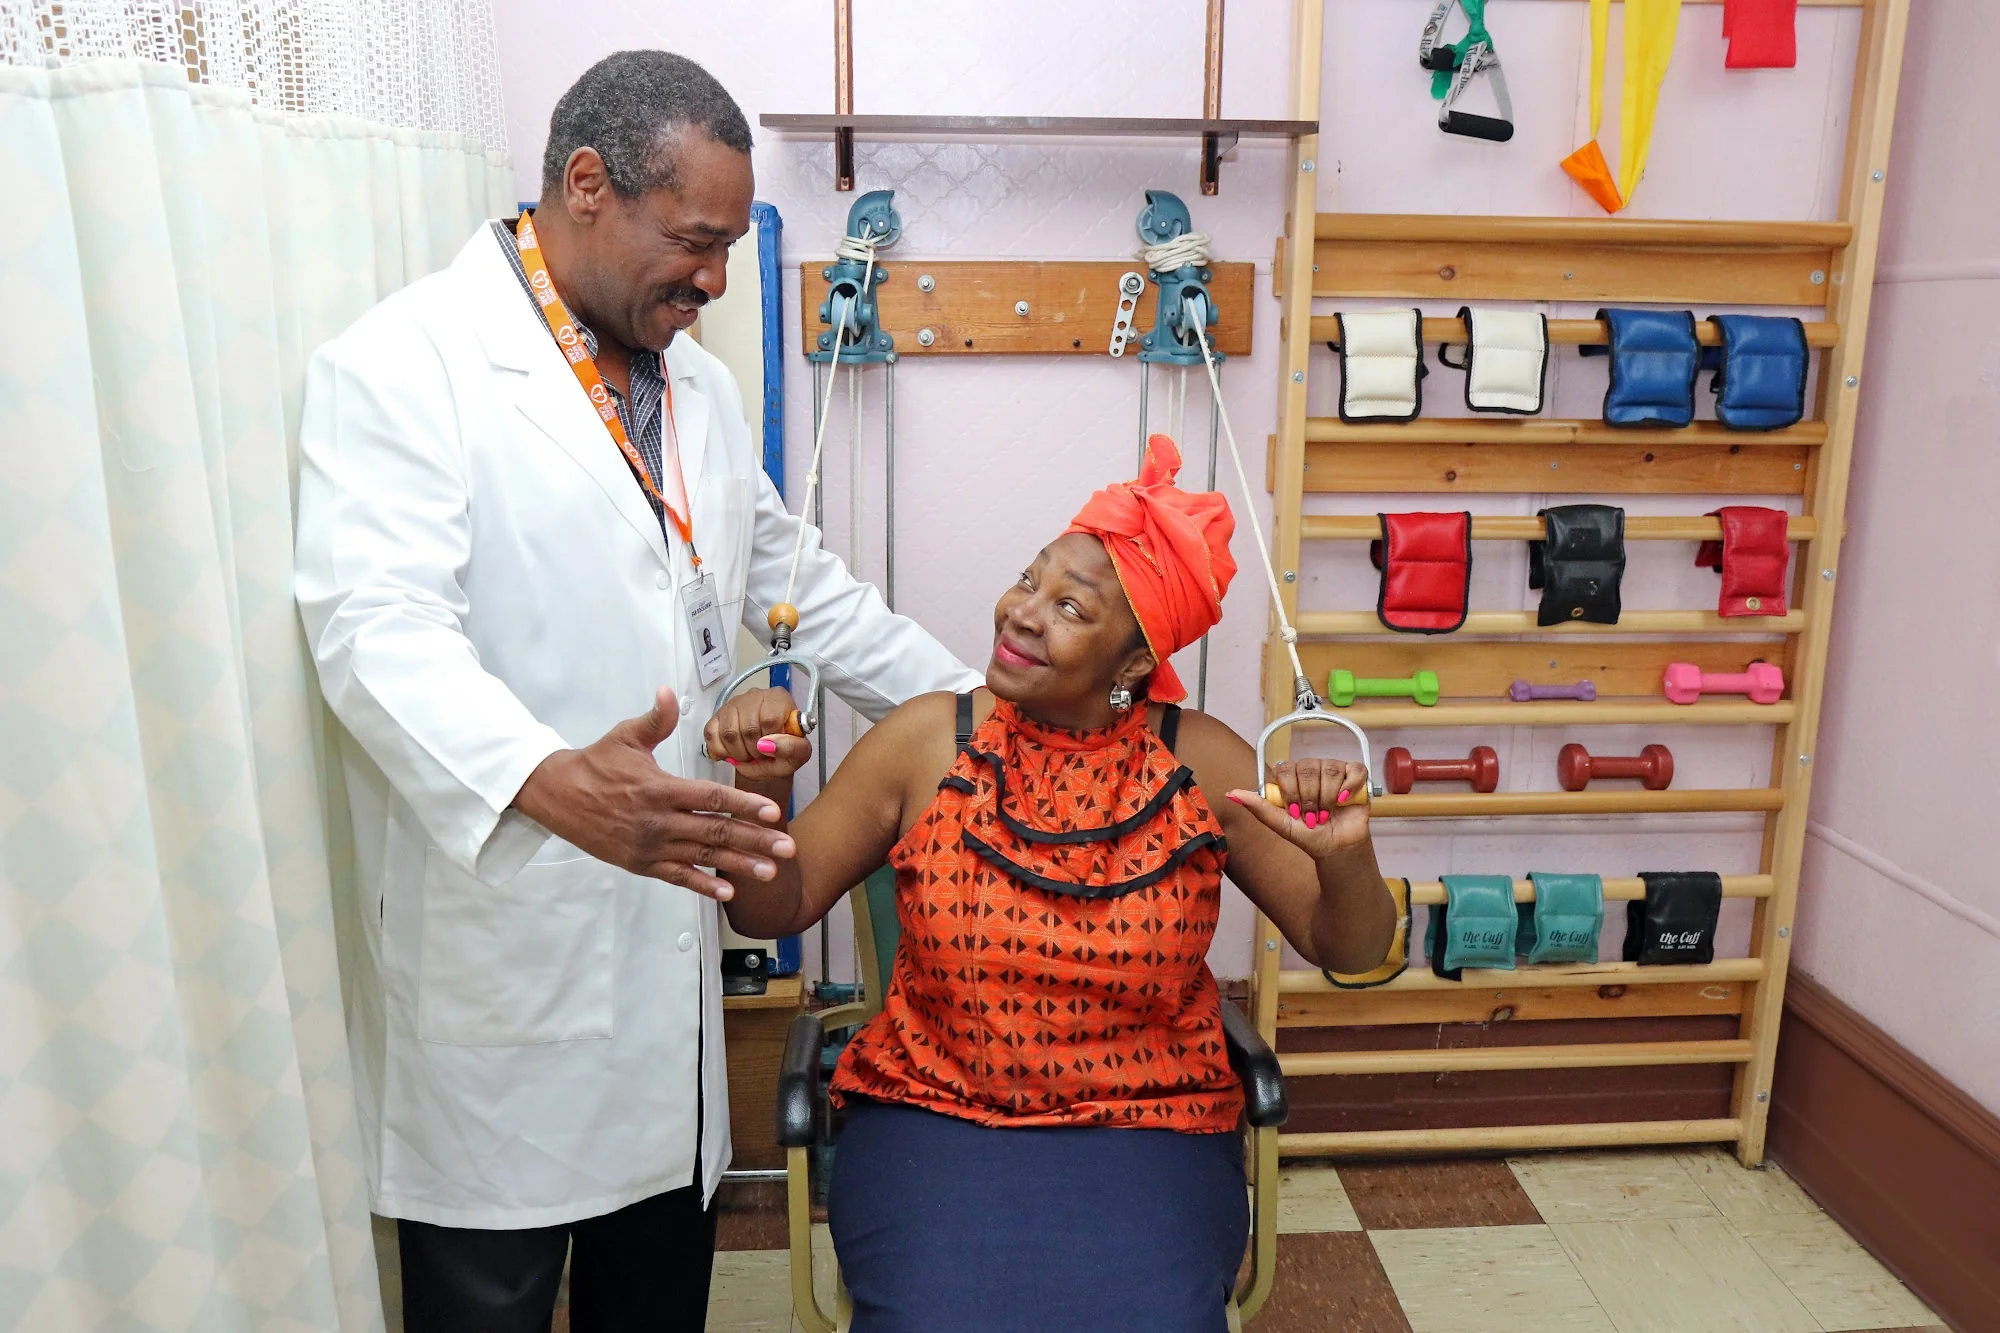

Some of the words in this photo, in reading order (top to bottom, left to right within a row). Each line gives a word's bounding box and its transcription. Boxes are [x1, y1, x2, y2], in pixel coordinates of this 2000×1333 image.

[565, 348, 578, 365] CARE
[598, 406, 610, 422] CARE
[1463, 931, 1480, 943] the
[1482, 931, 1503, 945] Cuff
[1549, 930, 1567, 942] the
[1569, 930, 1589, 944] Cuff
[1659, 933, 1678, 944] the
[1680, 931, 1701, 944] Cuff
